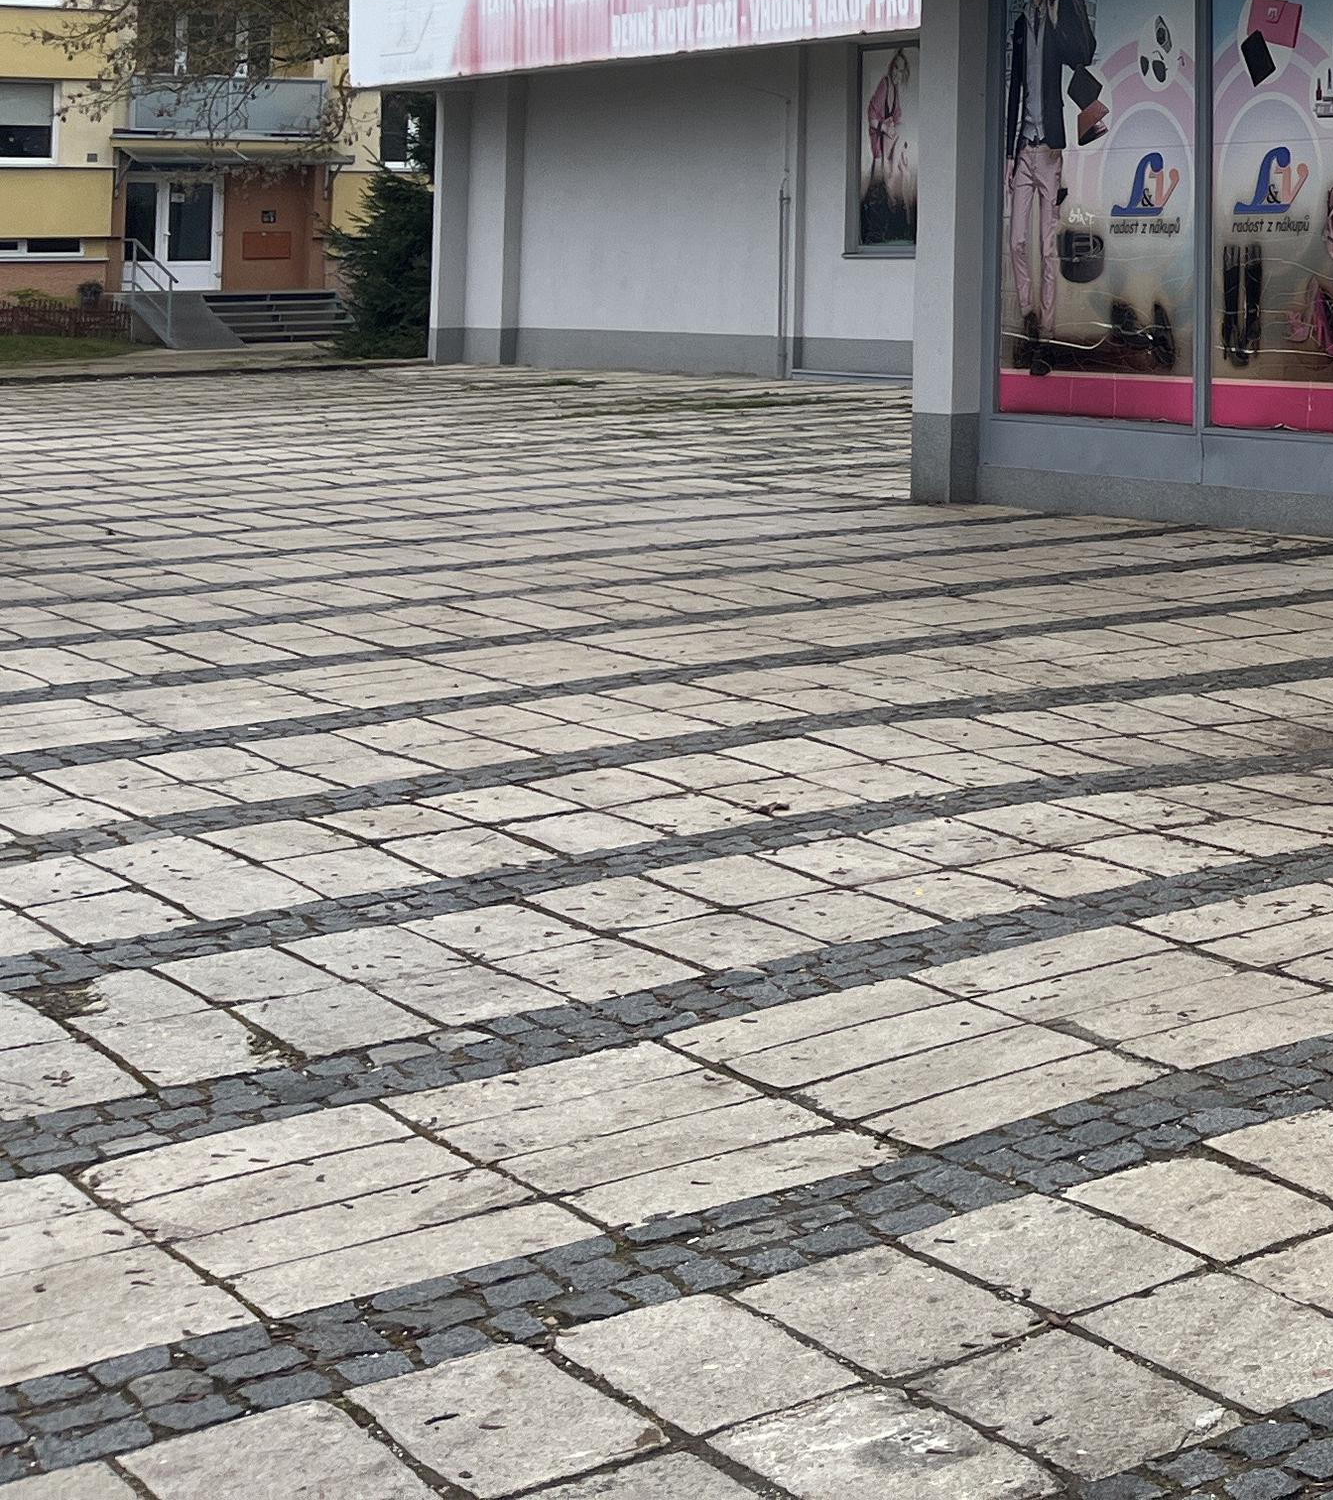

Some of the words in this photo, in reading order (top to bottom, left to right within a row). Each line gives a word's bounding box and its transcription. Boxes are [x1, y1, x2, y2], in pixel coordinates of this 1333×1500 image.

[1109, 220, 1138, 235] radost
[1141, 223, 1146, 233] z
[1150, 218, 1180, 235] nákupů
[1232, 218, 1263, 233] radost
[1267, 221, 1273, 232] z
[1276, 215, 1310, 236] nákupů
